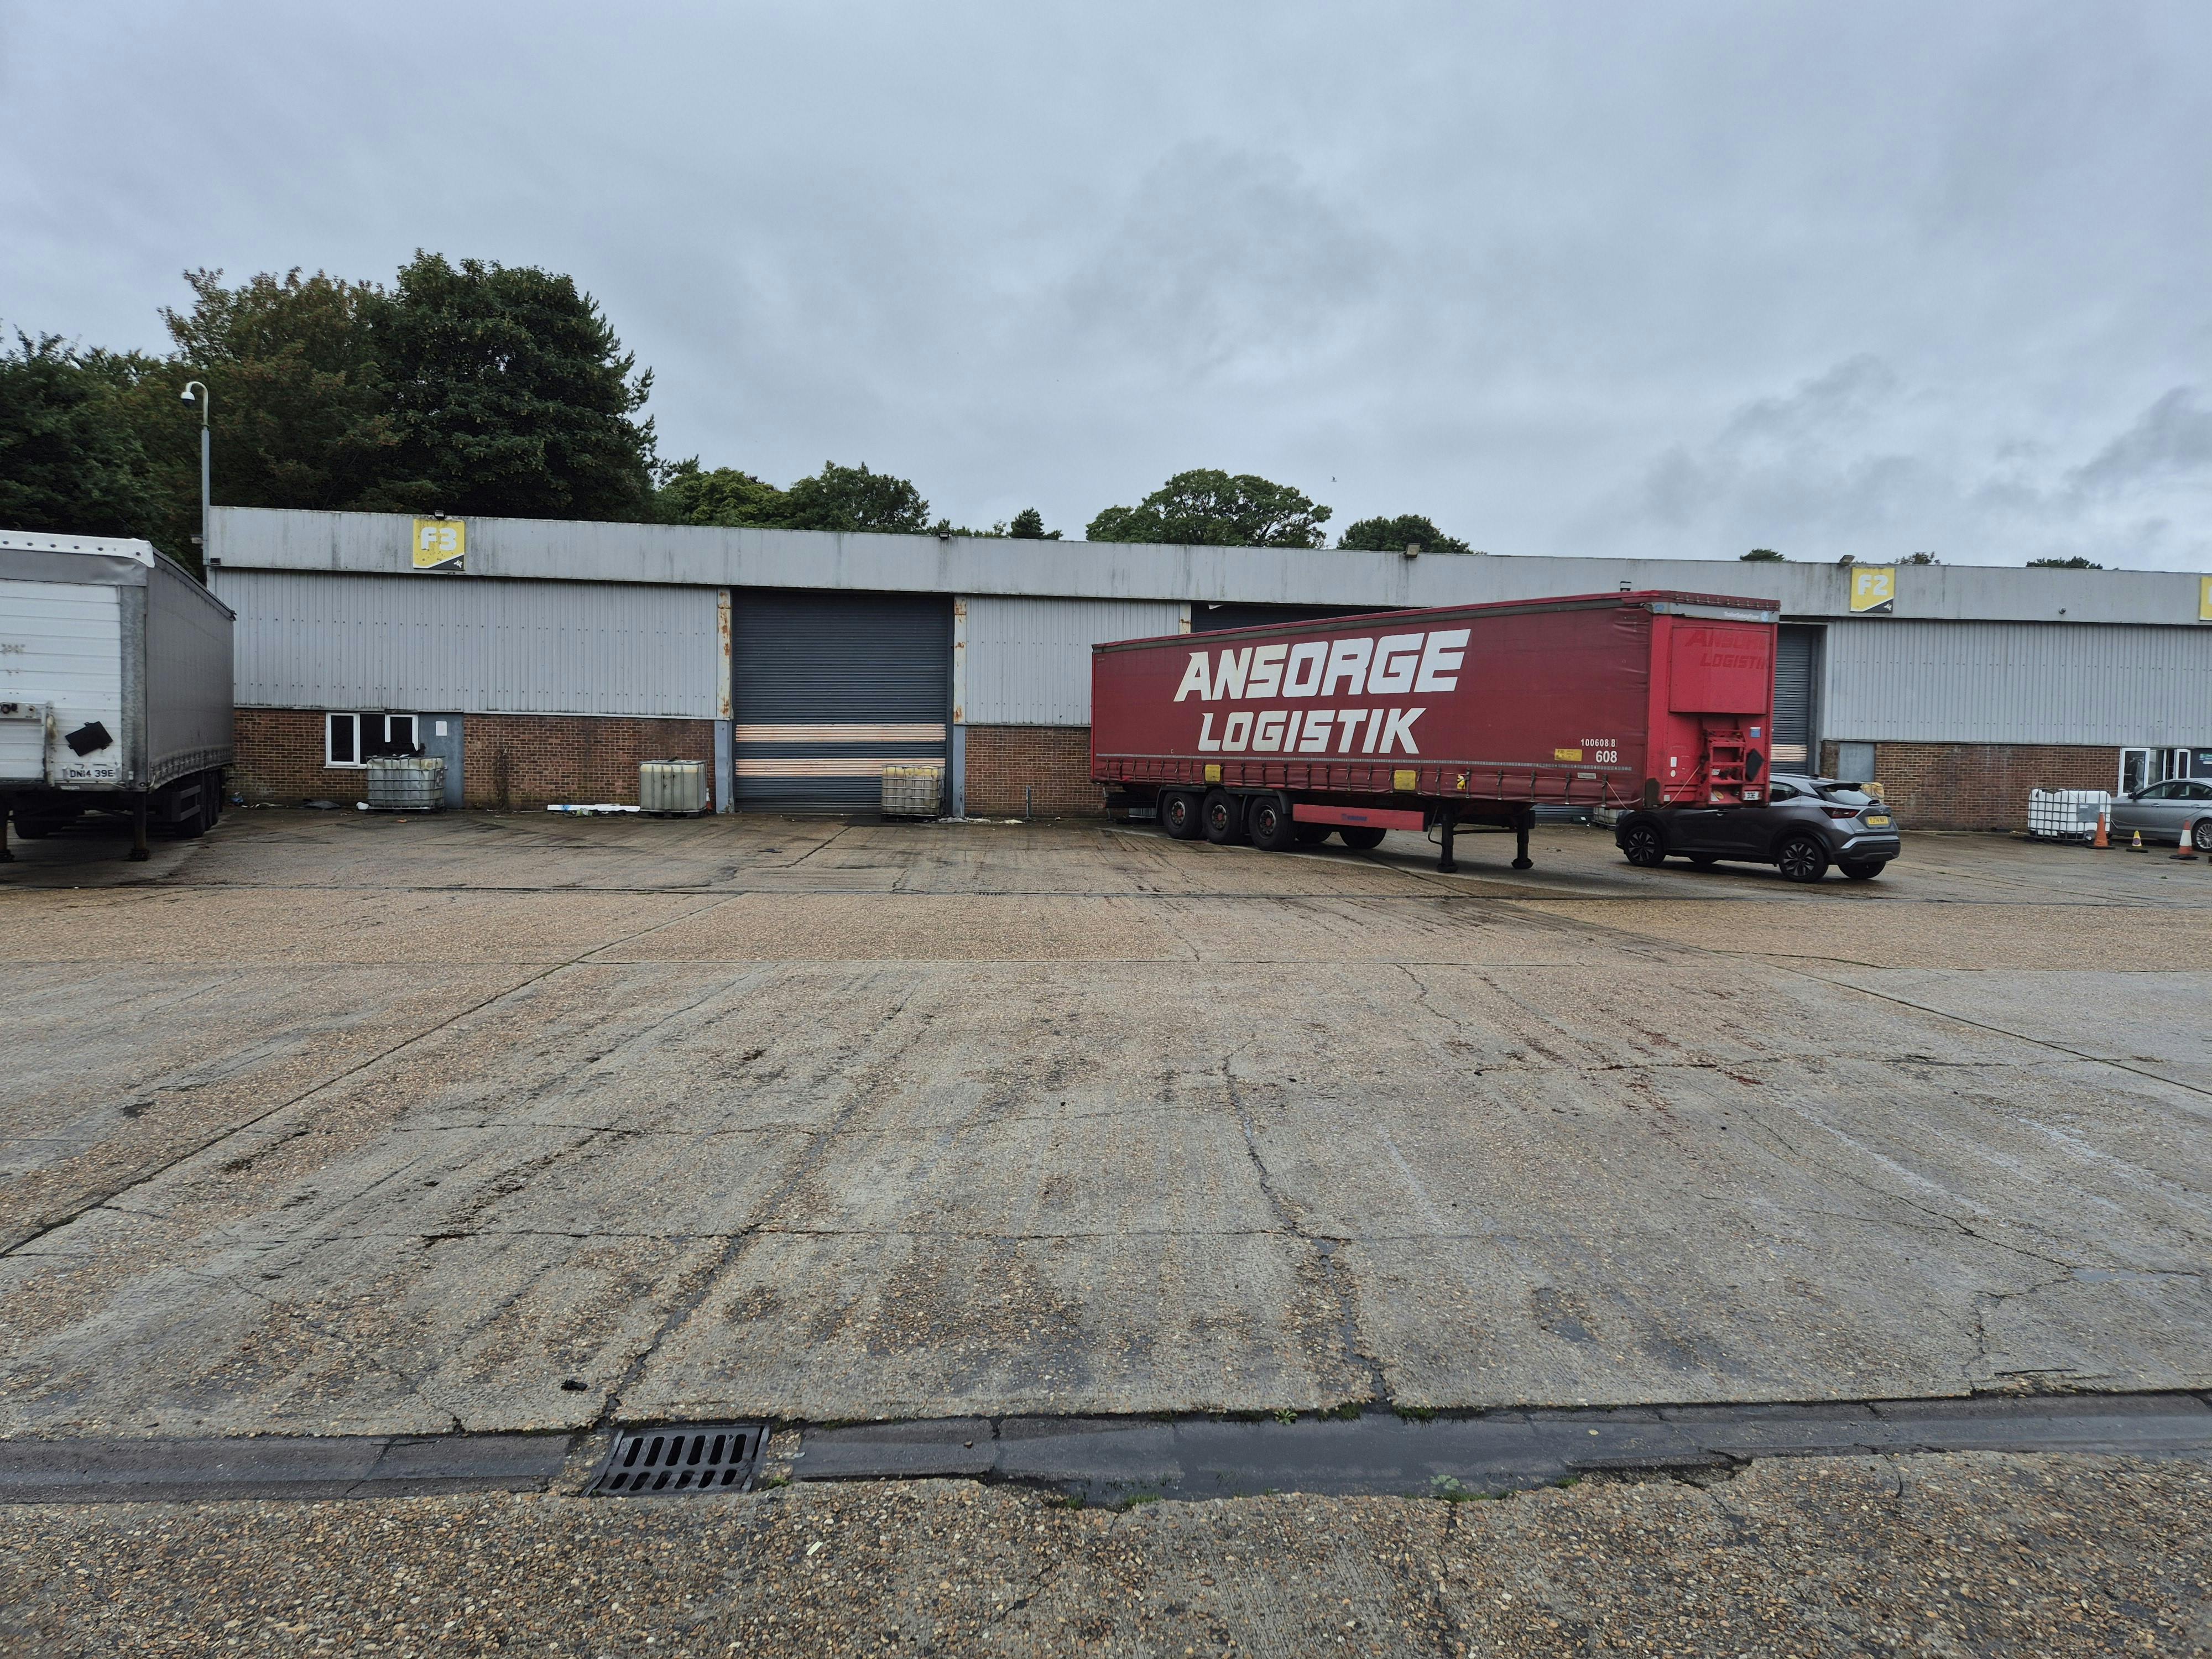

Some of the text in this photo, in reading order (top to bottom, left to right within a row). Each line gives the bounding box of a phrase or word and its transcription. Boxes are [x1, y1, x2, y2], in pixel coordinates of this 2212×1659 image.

[421, 526, 457, 551] F3
[1858, 573, 1888, 596] F2
[1173, 629, 1471, 702] ANSORGE
[1198, 708, 1427, 754] LOGISTIK
[1595, 750, 1618, 763] 608
